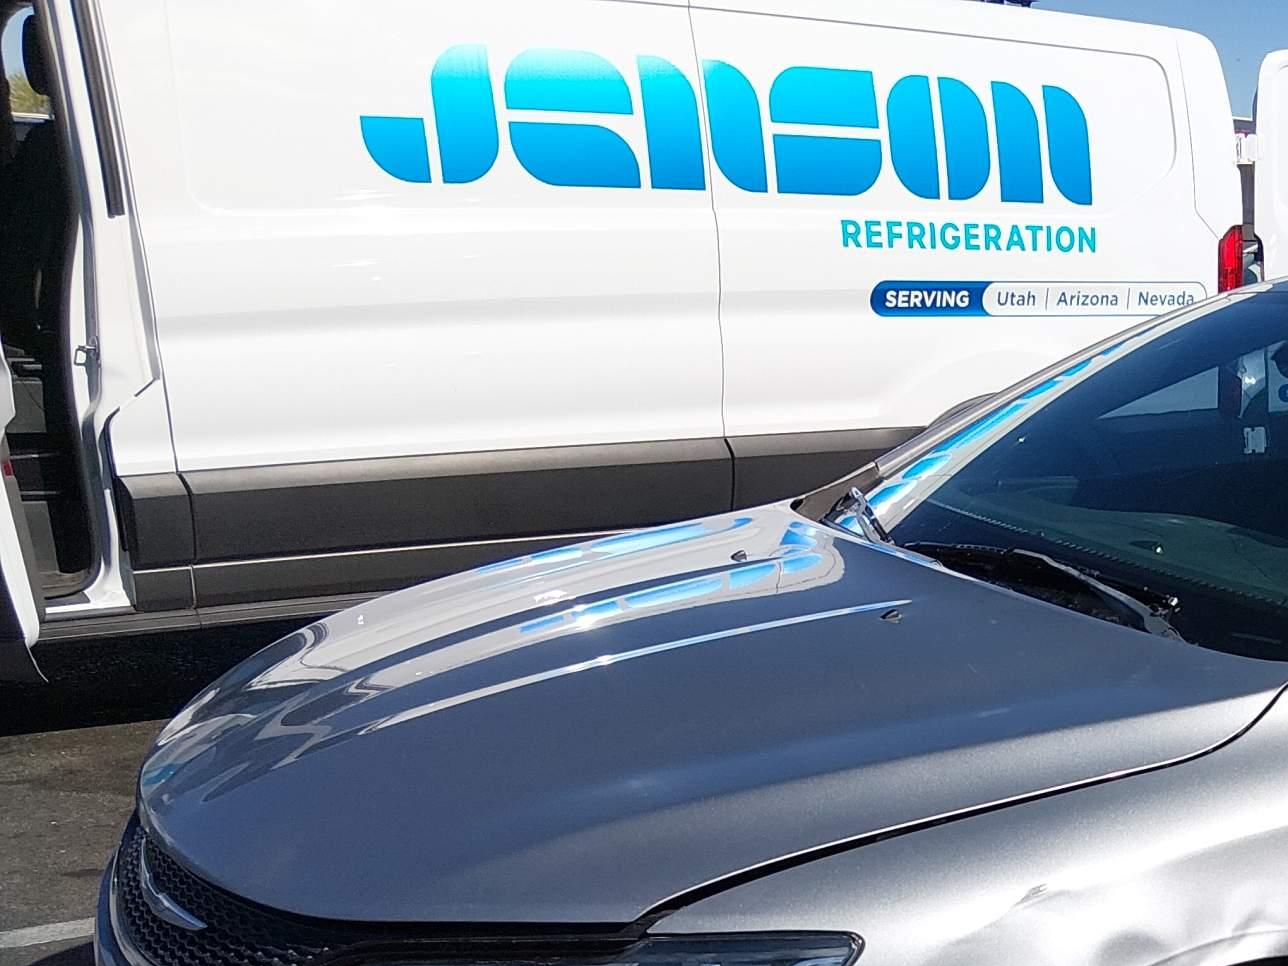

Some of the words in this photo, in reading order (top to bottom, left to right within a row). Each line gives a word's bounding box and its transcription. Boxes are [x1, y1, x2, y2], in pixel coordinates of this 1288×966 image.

[840, 218, 1098, 254] REFRIGERATION
[884, 290, 970, 308] SERVING
[997, 290, 1036, 307] Utah
[1056, 291, 1119, 307] Arizona
[1137, 290, 1195, 307] Nevada
